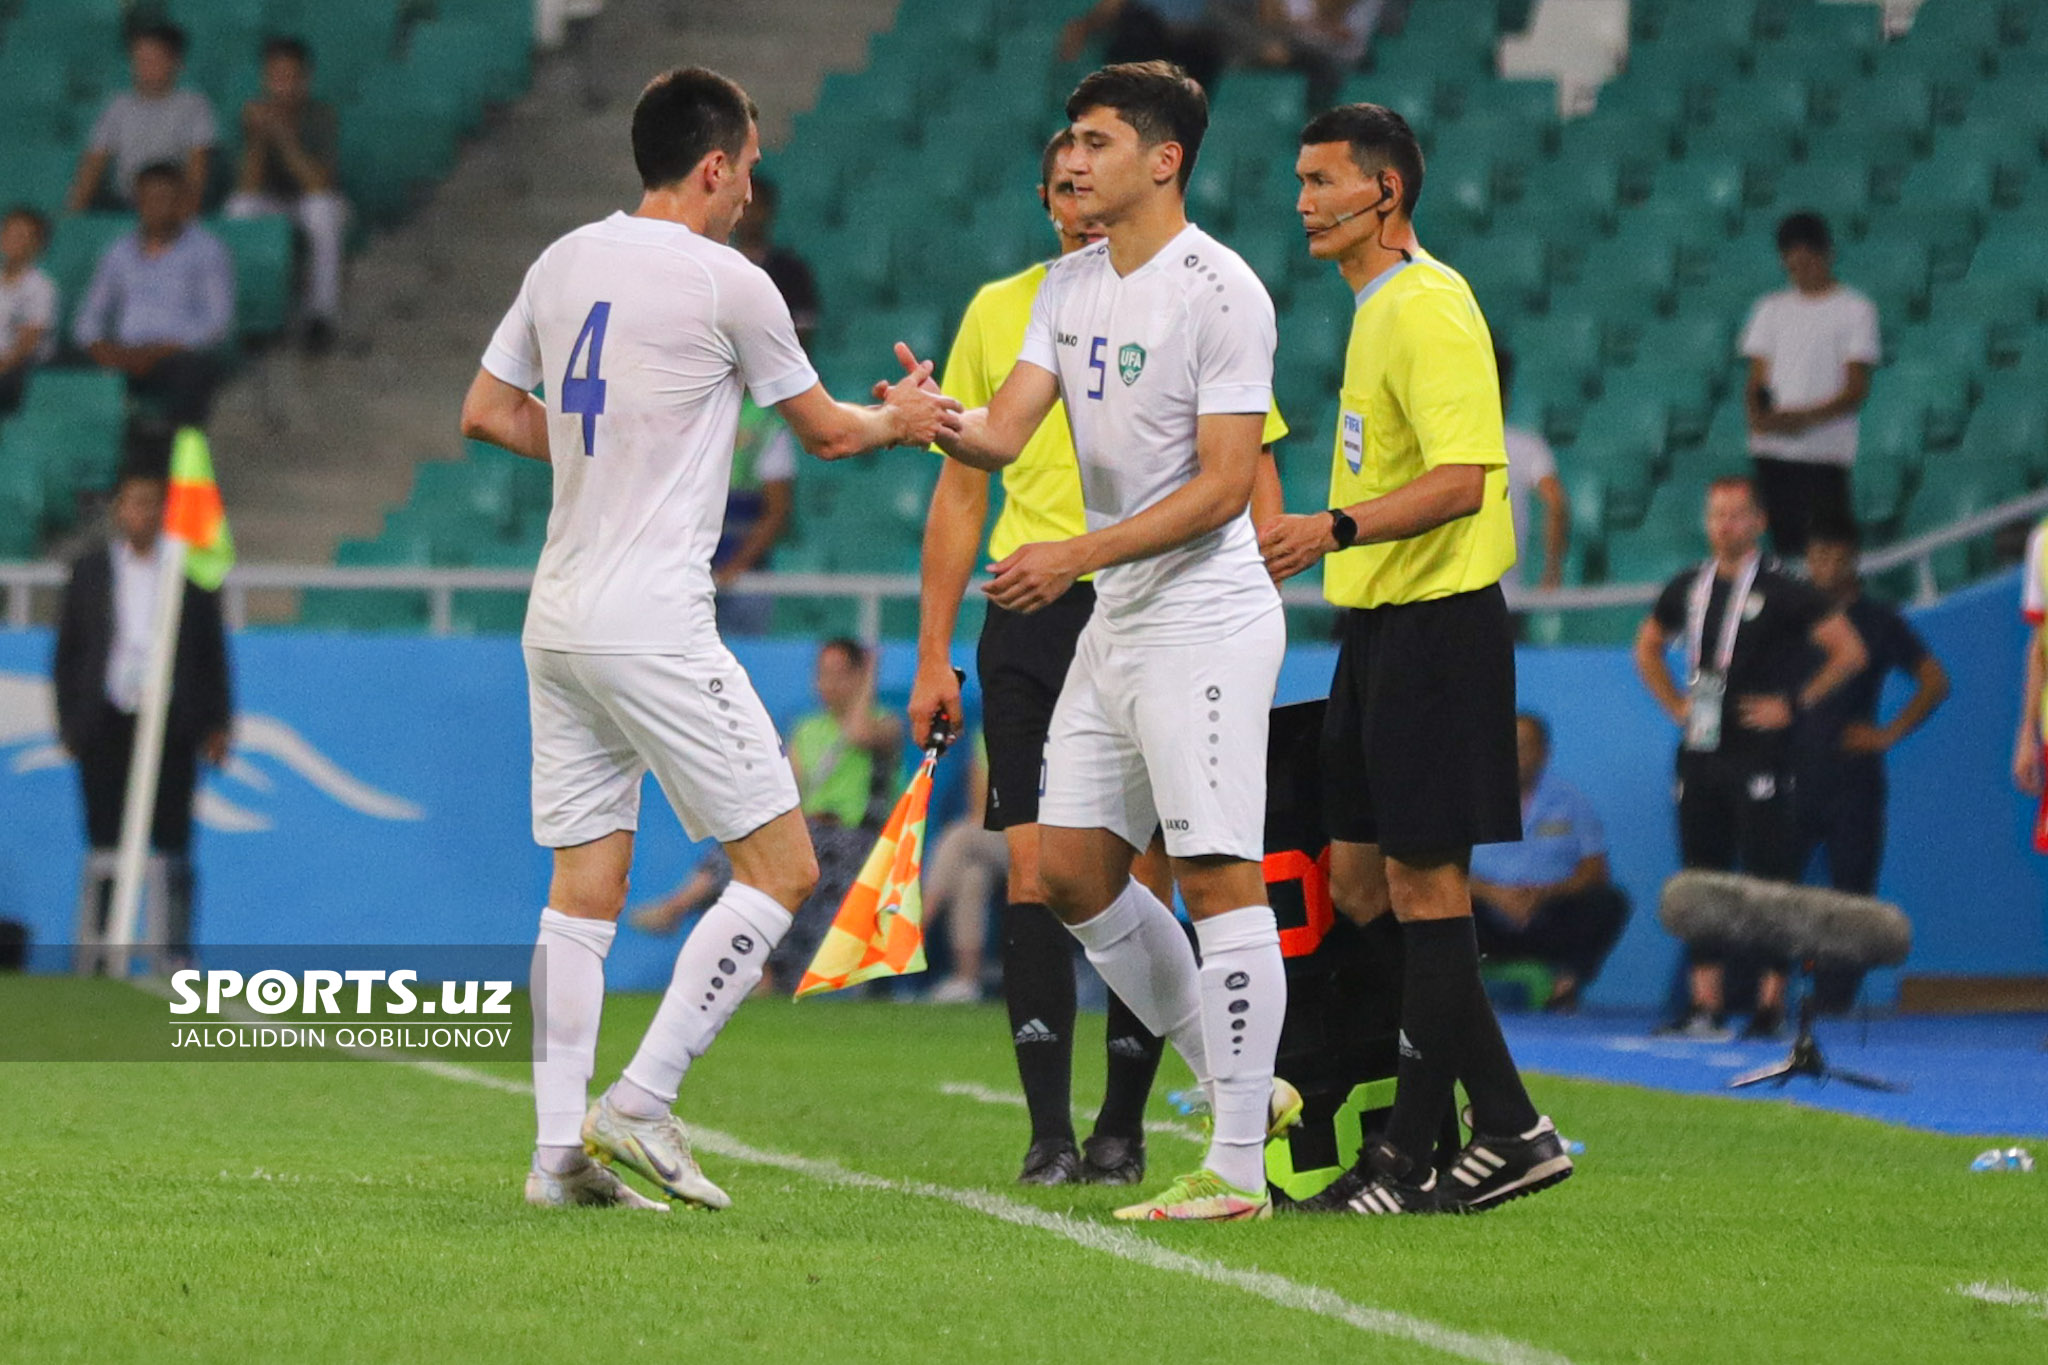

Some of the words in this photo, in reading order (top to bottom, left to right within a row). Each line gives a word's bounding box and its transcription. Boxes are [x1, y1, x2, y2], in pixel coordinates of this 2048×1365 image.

[1057, 333, 1078, 347] JAKO
[1088, 336, 1107, 400] 5
[1121, 350, 1141, 368] UFA
[561, 300, 612, 457] 4
[1165, 819, 1189, 831] JAKO
